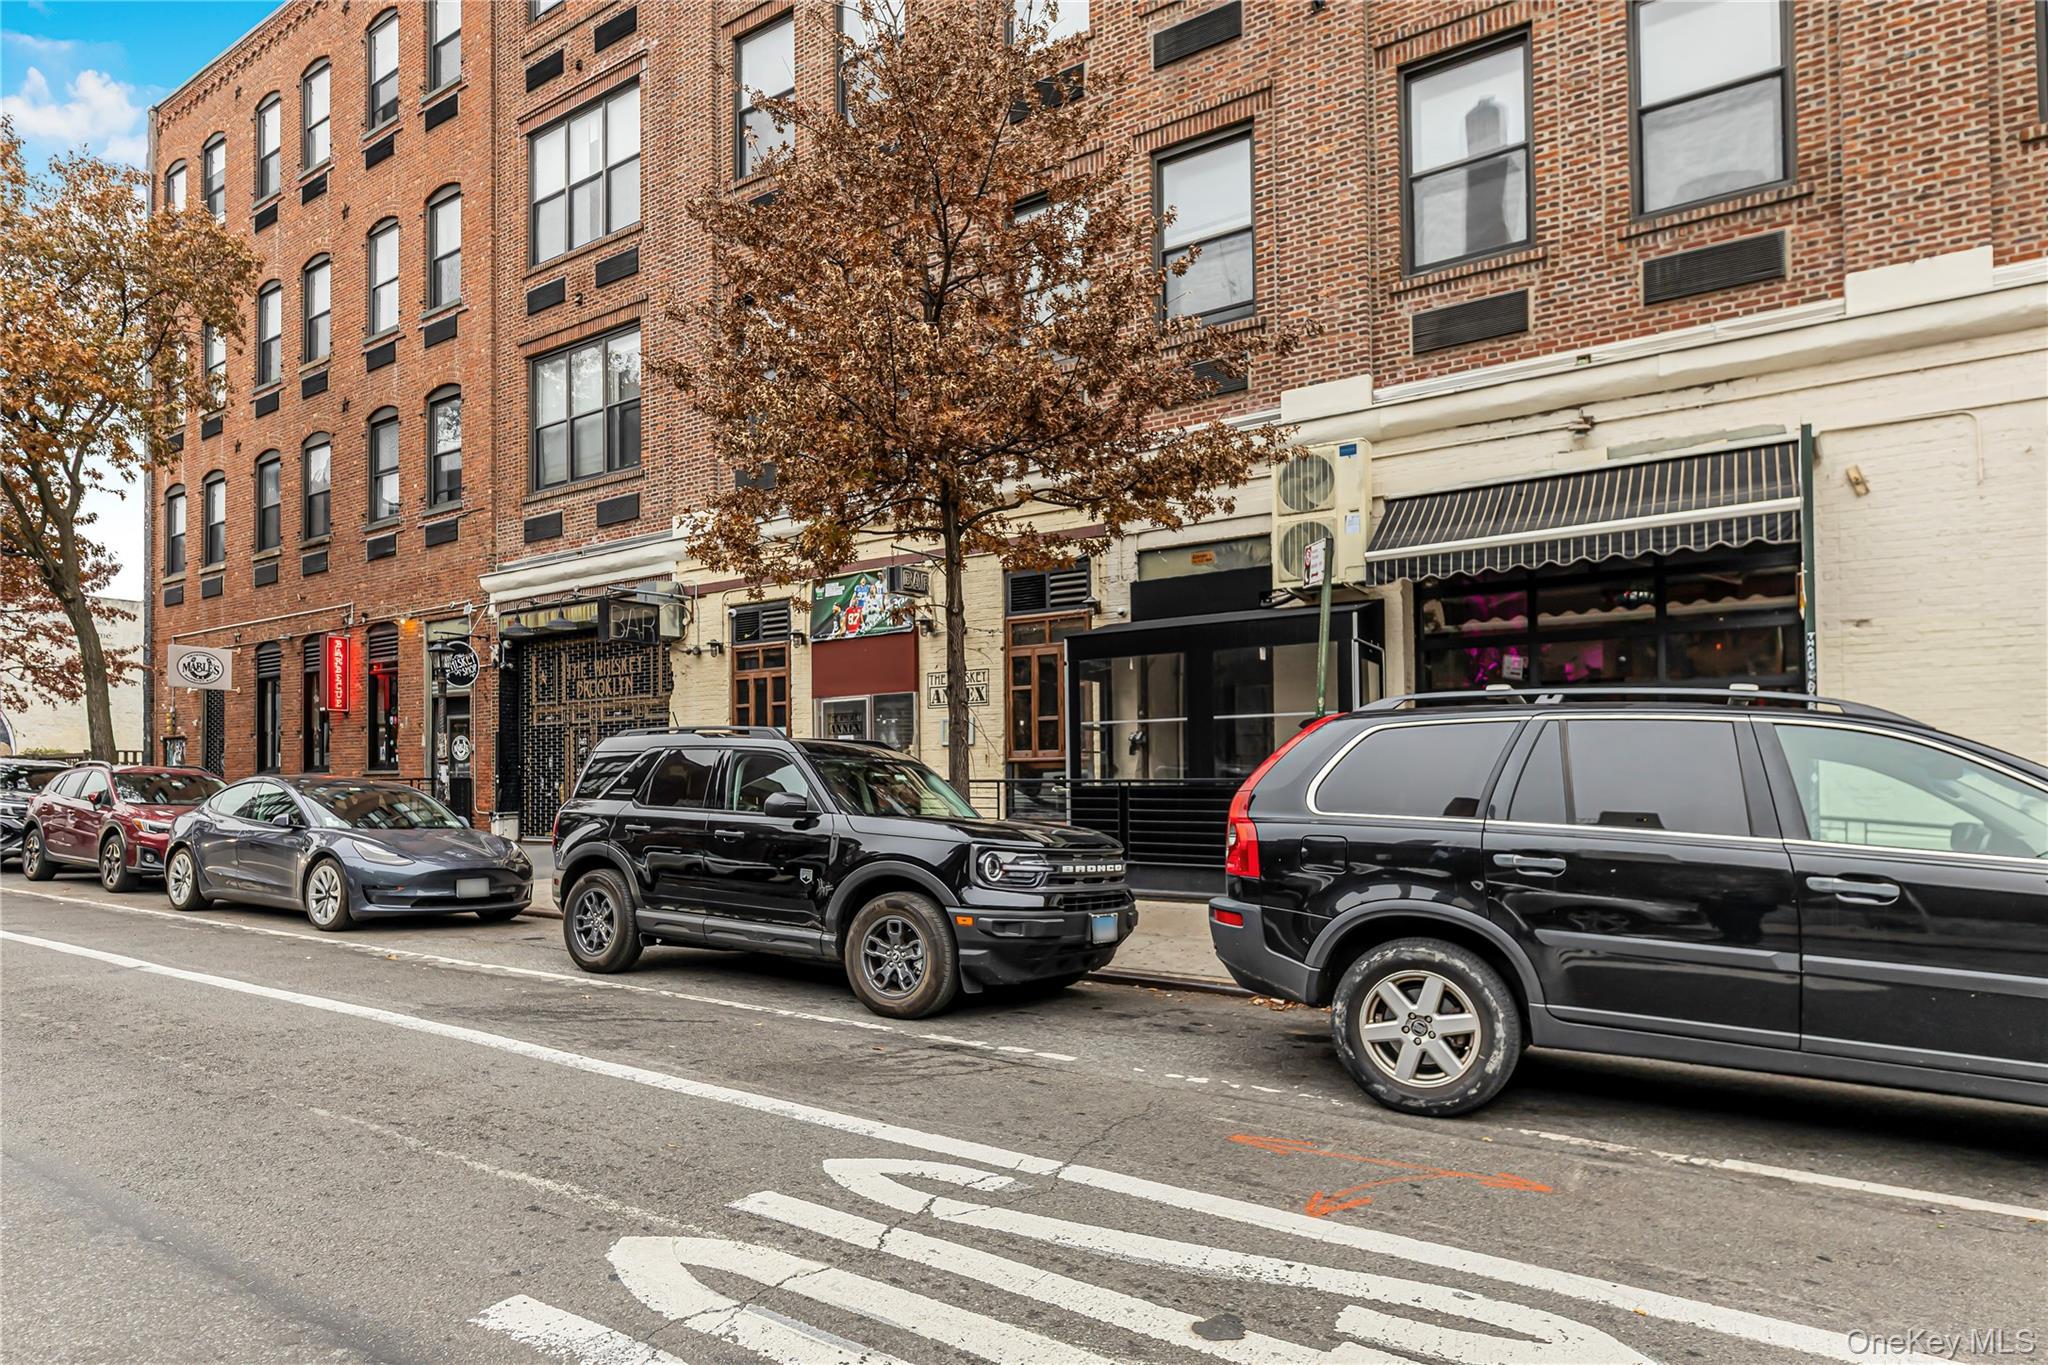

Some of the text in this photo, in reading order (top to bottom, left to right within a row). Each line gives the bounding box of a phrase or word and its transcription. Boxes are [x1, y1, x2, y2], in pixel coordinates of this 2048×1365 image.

[903, 569, 929, 592] BAR
[610, 604, 656, 643] BAR
[848, 613, 860, 626] 87
[334, 639, 343, 708] BARBECUE
[567, 655, 643, 680] THE WHISKEY
[576, 675, 634, 699] BROOKLYN
[929, 674, 947, 686] THE
[1061, 864, 1123, 873] BRONCO
